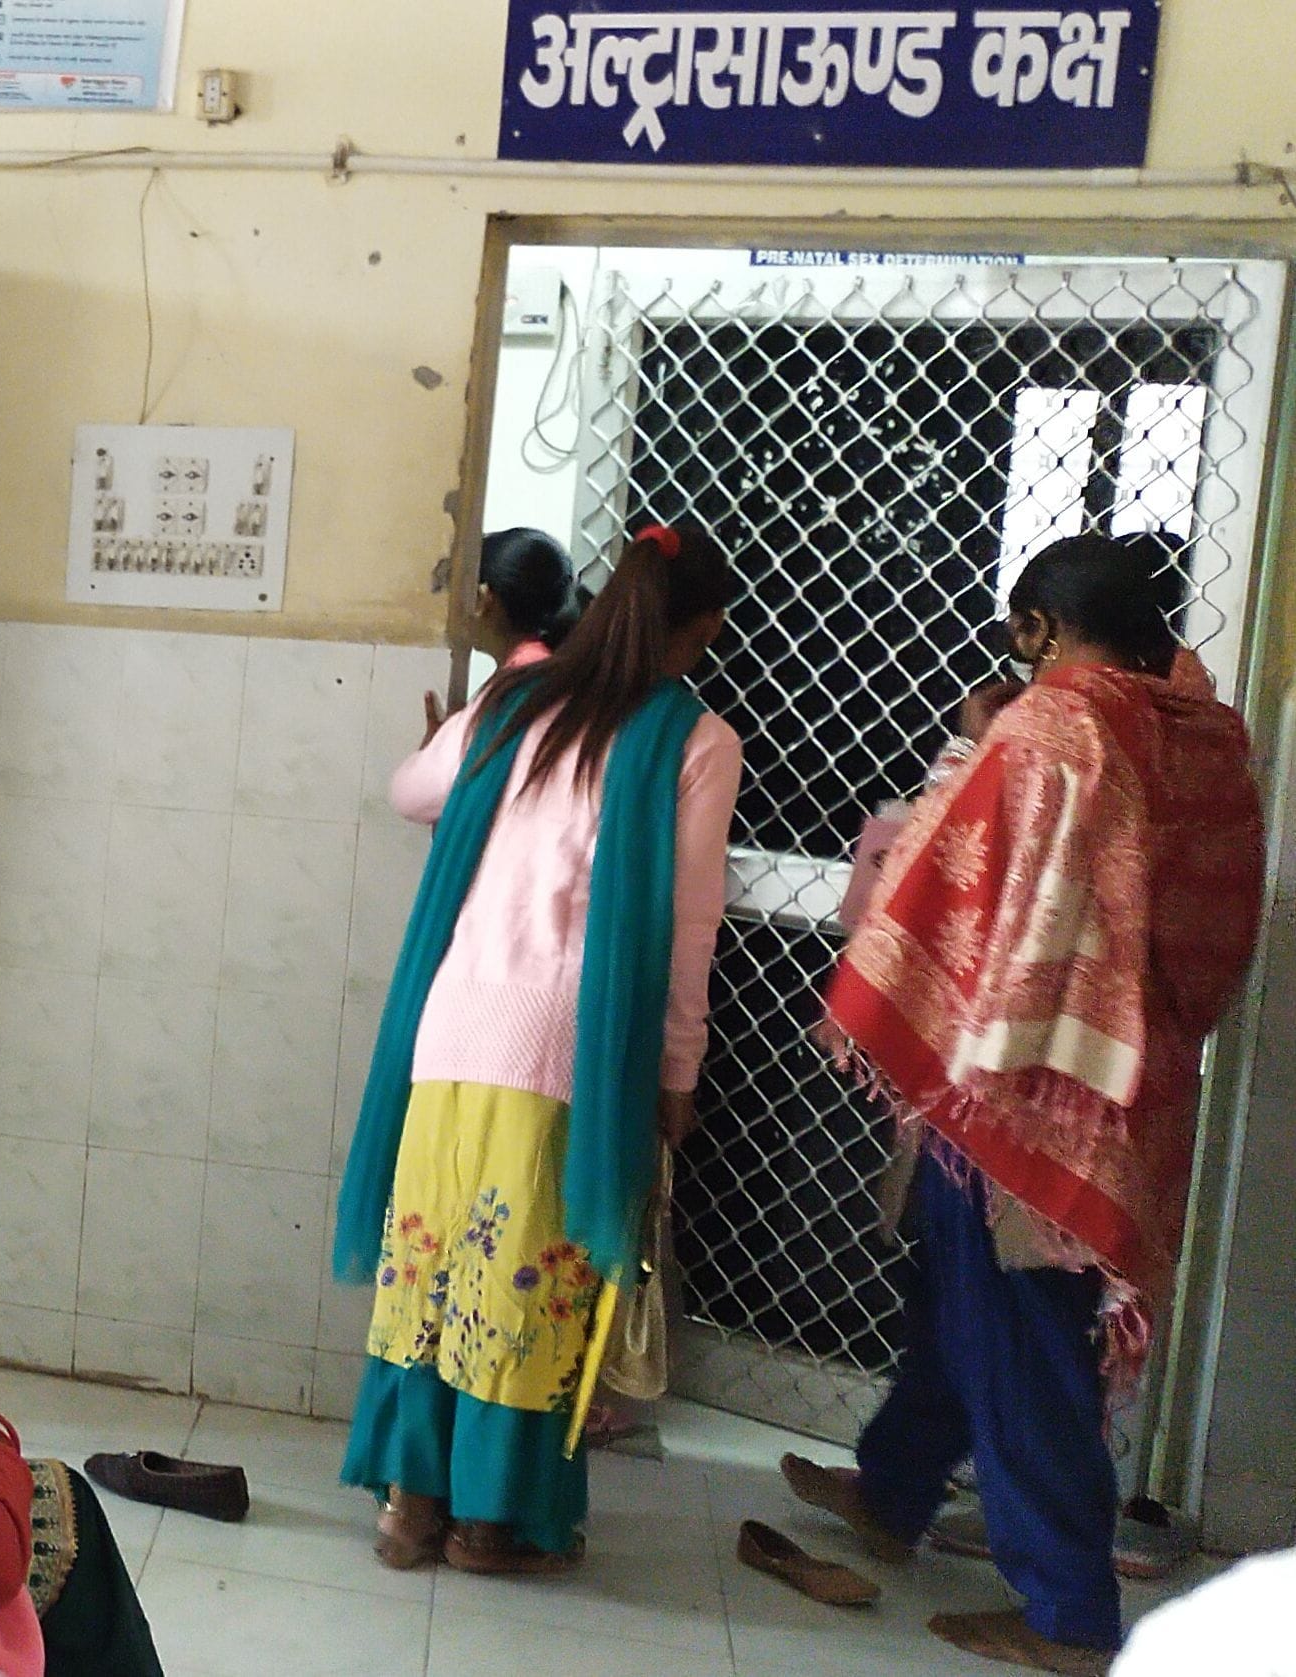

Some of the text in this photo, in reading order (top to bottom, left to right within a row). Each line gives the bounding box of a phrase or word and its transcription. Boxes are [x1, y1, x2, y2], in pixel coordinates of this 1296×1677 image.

[519, 10, 1131, 153] अल्ट्रासाऊण्ड कक्ष
[755, 250, 845, 265] PRE-NATAL
[848, 252, 879, 265] SEX
